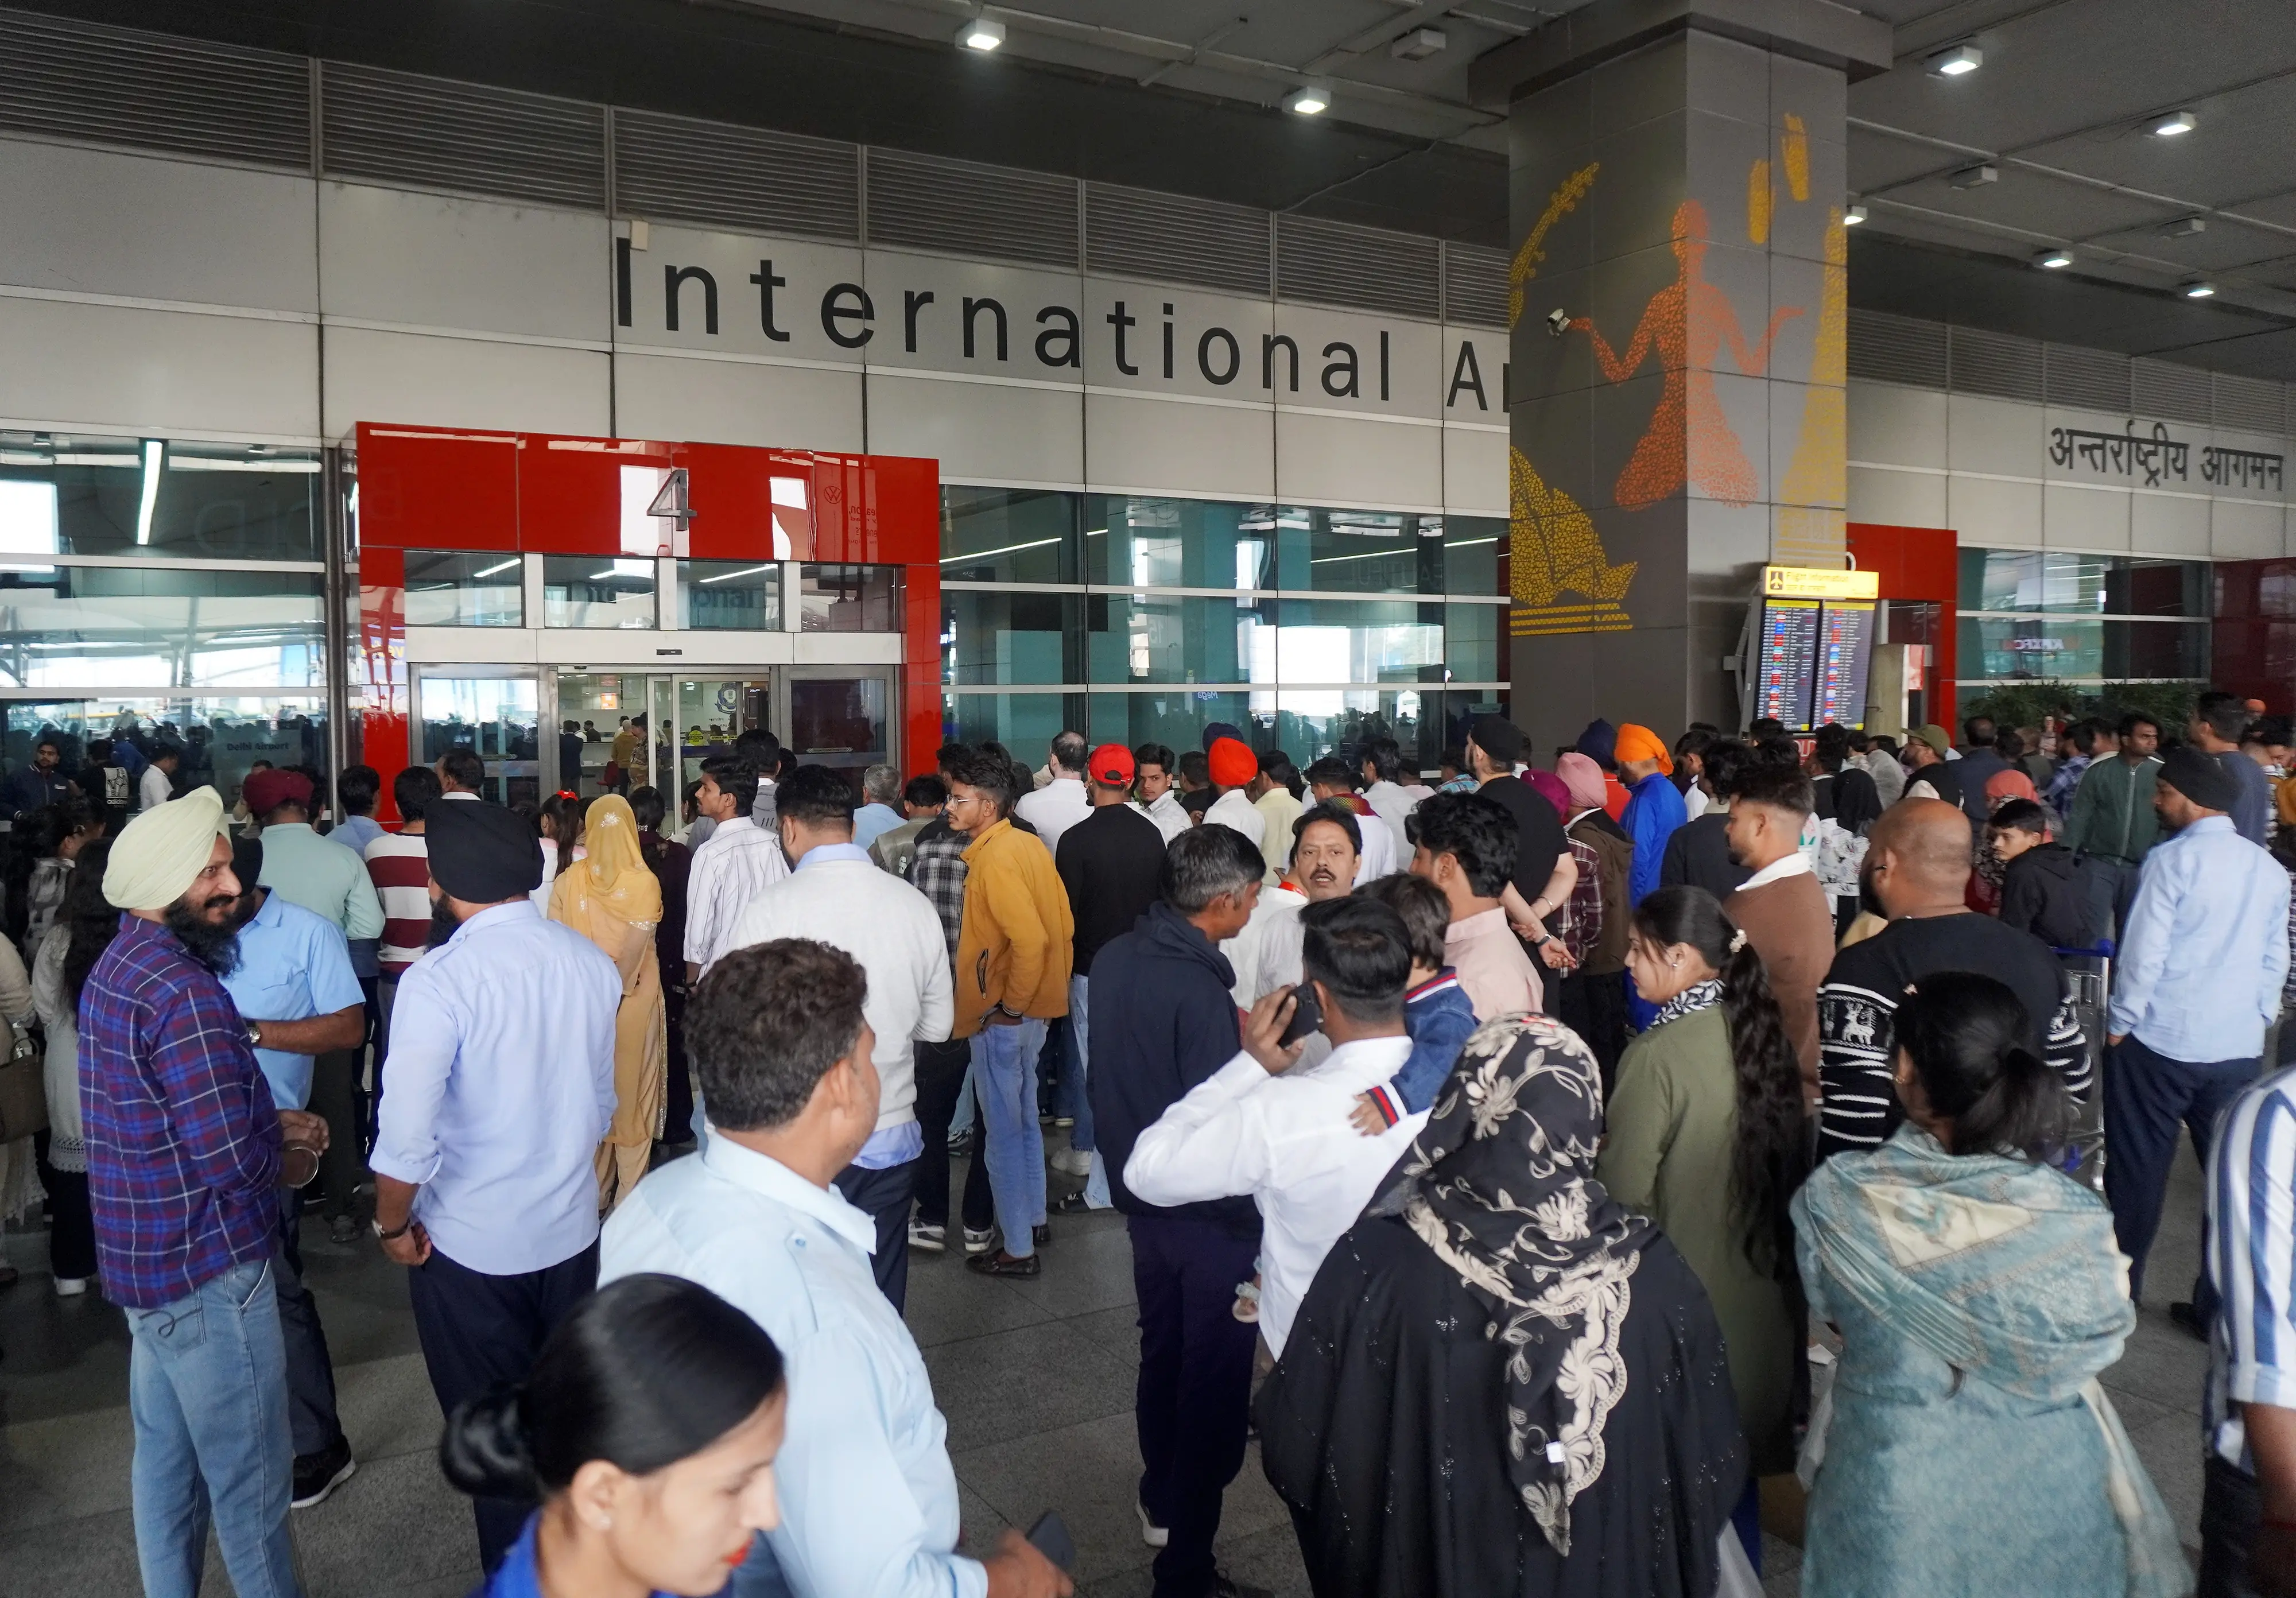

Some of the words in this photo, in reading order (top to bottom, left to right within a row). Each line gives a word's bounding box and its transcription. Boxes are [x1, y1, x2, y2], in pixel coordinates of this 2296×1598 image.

[616, 236, 1389, 402] International
[2049, 420, 2190, 487] अन्तर्राष्ट्रीय
[2200, 445, 2284, 491] आगमन
[646, 469, 697, 532] 4
[1786, 572, 1807, 582] Flight
[1809, 573, 1849, 583] Information
[227, 742, 252, 751] Delhi
[255, 742, 290, 751] Airport
